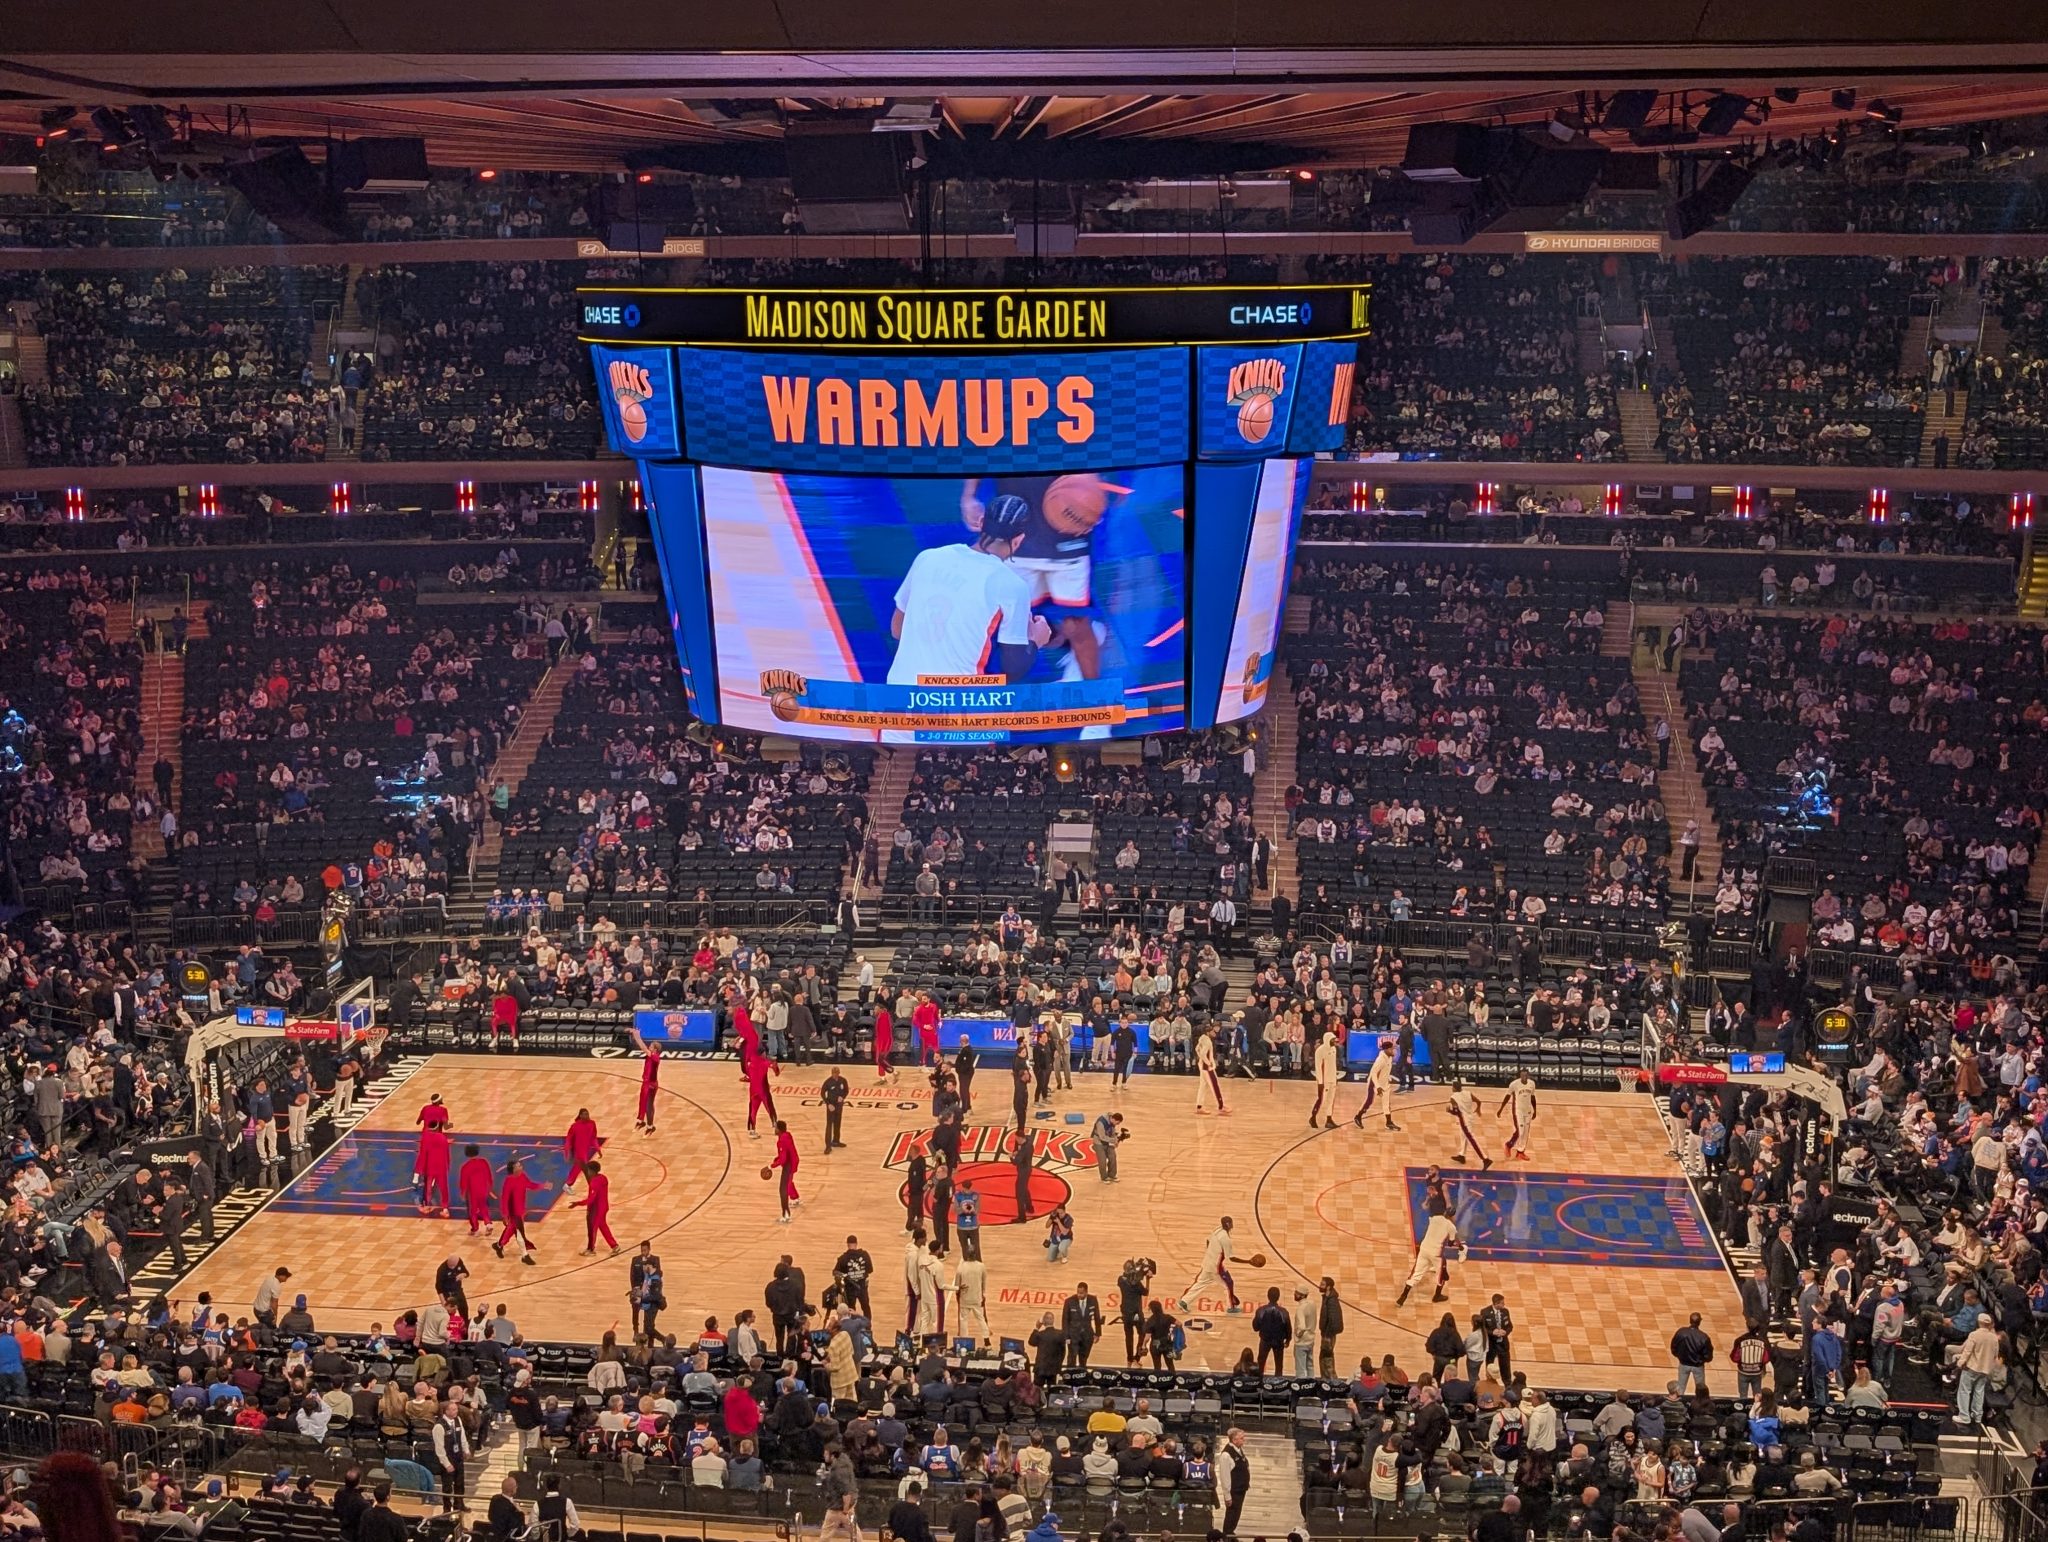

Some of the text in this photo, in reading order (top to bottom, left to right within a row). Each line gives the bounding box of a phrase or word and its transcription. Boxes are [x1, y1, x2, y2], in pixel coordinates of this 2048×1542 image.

[1552, 238, 1659, 249] HYUNDAI BRIDGE
[663, 243, 701, 254] RIDGE
[584, 306, 621, 324] CHASE
[746, 295, 1106, 342] MADISON SQUARE GARDEN
[1230, 305, 1298, 324] CHASE
[1227, 358, 1286, 404] KNICKS
[762, 375, 1095, 447] WARMUPS
[759, 669, 808, 696] KNICKS
[924, 676, 1000, 685] KNICKS CAREER
[907, 691, 1016, 708] JOSH HART
[819, 712, 855, 723] KNICKS
[857, 715, 877, 724] ARE
[879, 717, 898, 726] 34-11
[900, 717, 925, 727] (.756)
[927, 717, 958, 727] WHEN
[961, 718, 988, 727] HART
[991, 716, 1039, 726] RECORDS
[1056, 711, 1112, 724] REBOUNDS
[928, 731, 1005, 740] 3-0 THIS SEASON
[187, 970, 205, 980] 5:30
[663, 1013, 689, 1027] KNICKS
[1825, 1017, 1846, 1028] 5:30
[576, 1035, 593, 1043] KIA
[594, 1035, 612, 1043] KIA
[1456, 1037, 1476, 1045] KIA
[1478, 1038, 1497, 1046] KIA
[1498, 1038, 1518, 1047] KIA
[1518, 1039, 1538, 1048] KIA
[1540, 1041, 1558, 1049] KIA
[1559, 1040, 1579, 1048] KIA
[1581, 1041, 1600, 1050] KIA
[1602, 1043, 1621, 1051] KIA
[1623, 1044, 1641, 1052] KIA
[1478, 1063, 1497, 1071] KIA
[1540, 1066, 1559, 1075] KIA
[1561, 1066, 1580, 1074] KIA
[1687, 1071, 1725, 1080] State Farm
[208, 1062, 219, 1104] Spectrum
[772, 1085, 821, 1096] ADISO
[850, 1087, 905, 1098] QUARE
[1805, 1119, 1816, 1155] ectrum
[1833, 1213, 1871, 1225] ectrum
[999, 1289, 1068, 1305] MADIS
[1158, 1375, 1173, 1383] razr
[1301, 1382, 1316, 1390] razr
